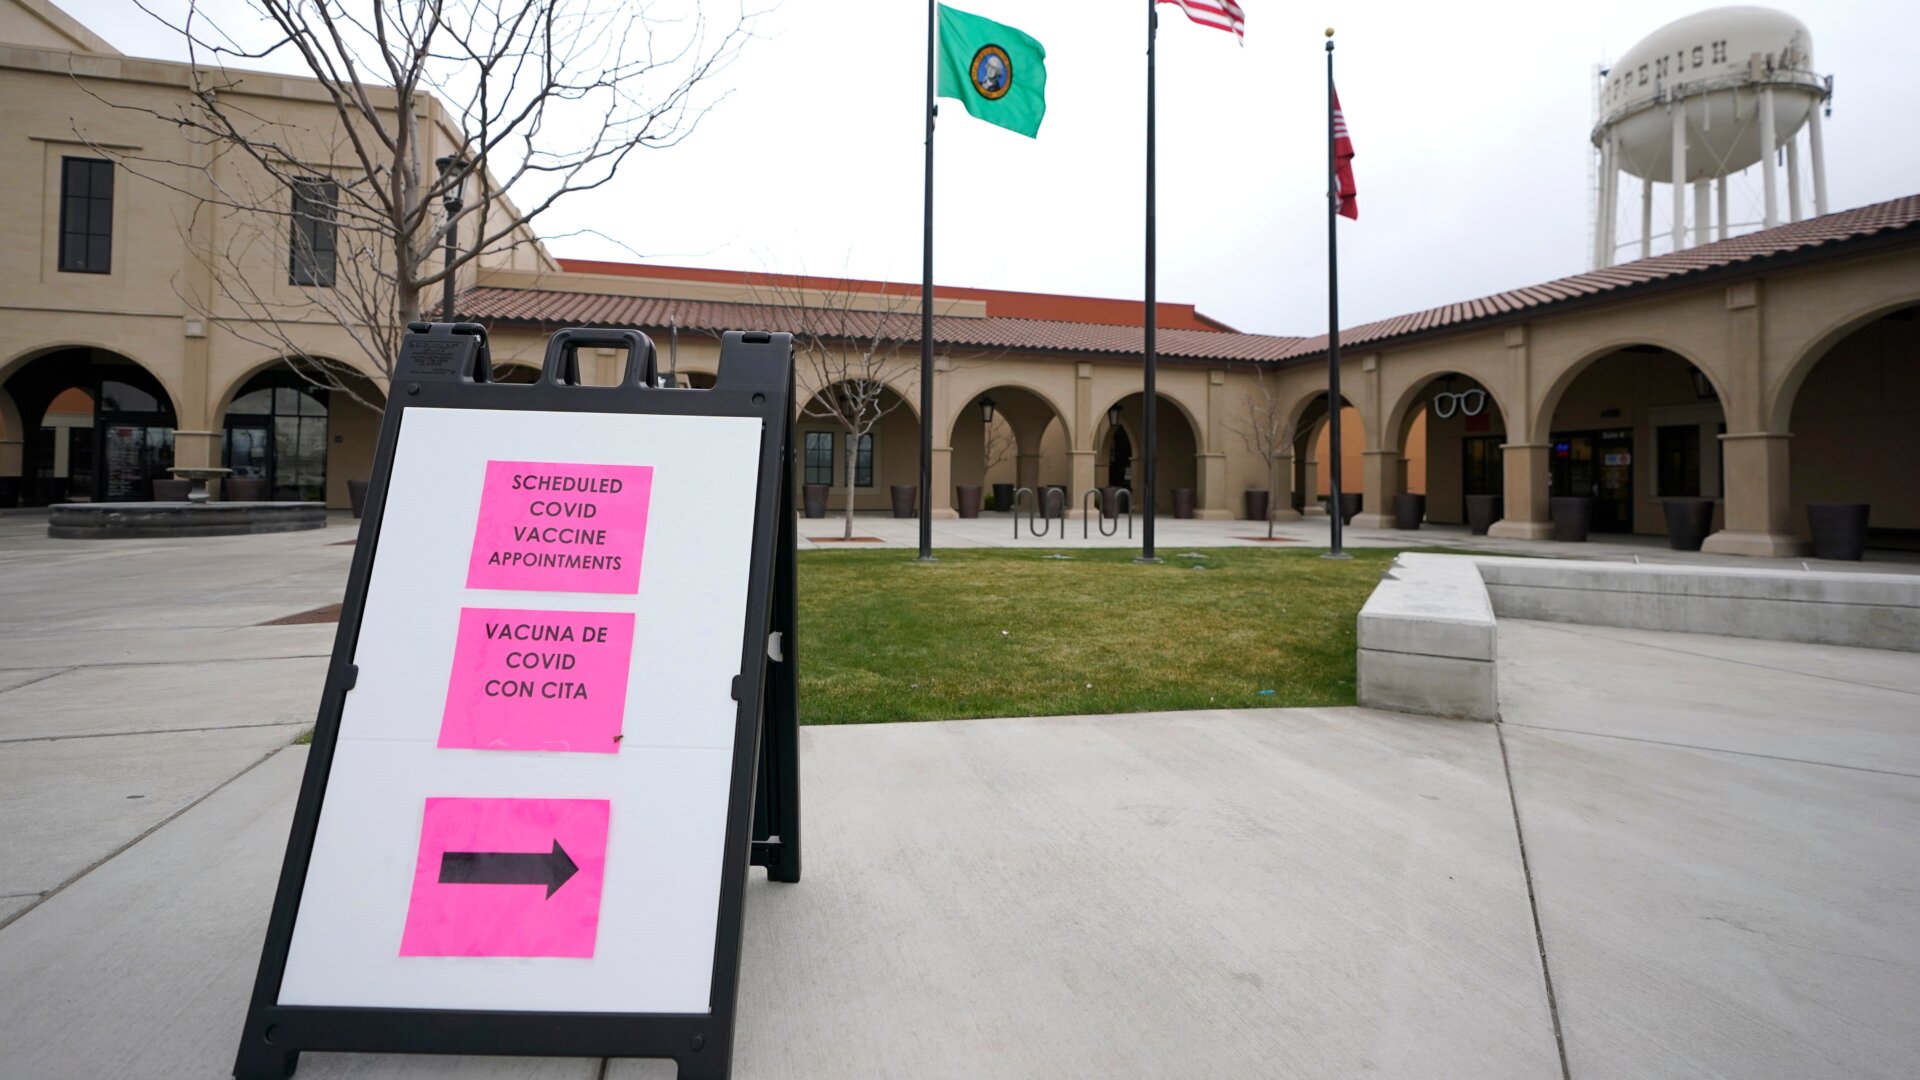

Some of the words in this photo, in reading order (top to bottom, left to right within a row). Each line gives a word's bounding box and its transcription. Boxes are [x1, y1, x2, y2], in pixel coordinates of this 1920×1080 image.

[511, 474, 623, 493] SCHEDULED
[529, 500, 597, 519] COVID
[513, 526, 607, 545] VACCINE
[487, 551, 622, 571] APPOINTMENTS
[485, 622, 575, 642] VACUNA
[582, 626, 608, 643] DE
[505, 651, 576, 670] COVID
[484, 679, 535, 698] CON
[541, 681, 588, 700] CITA
